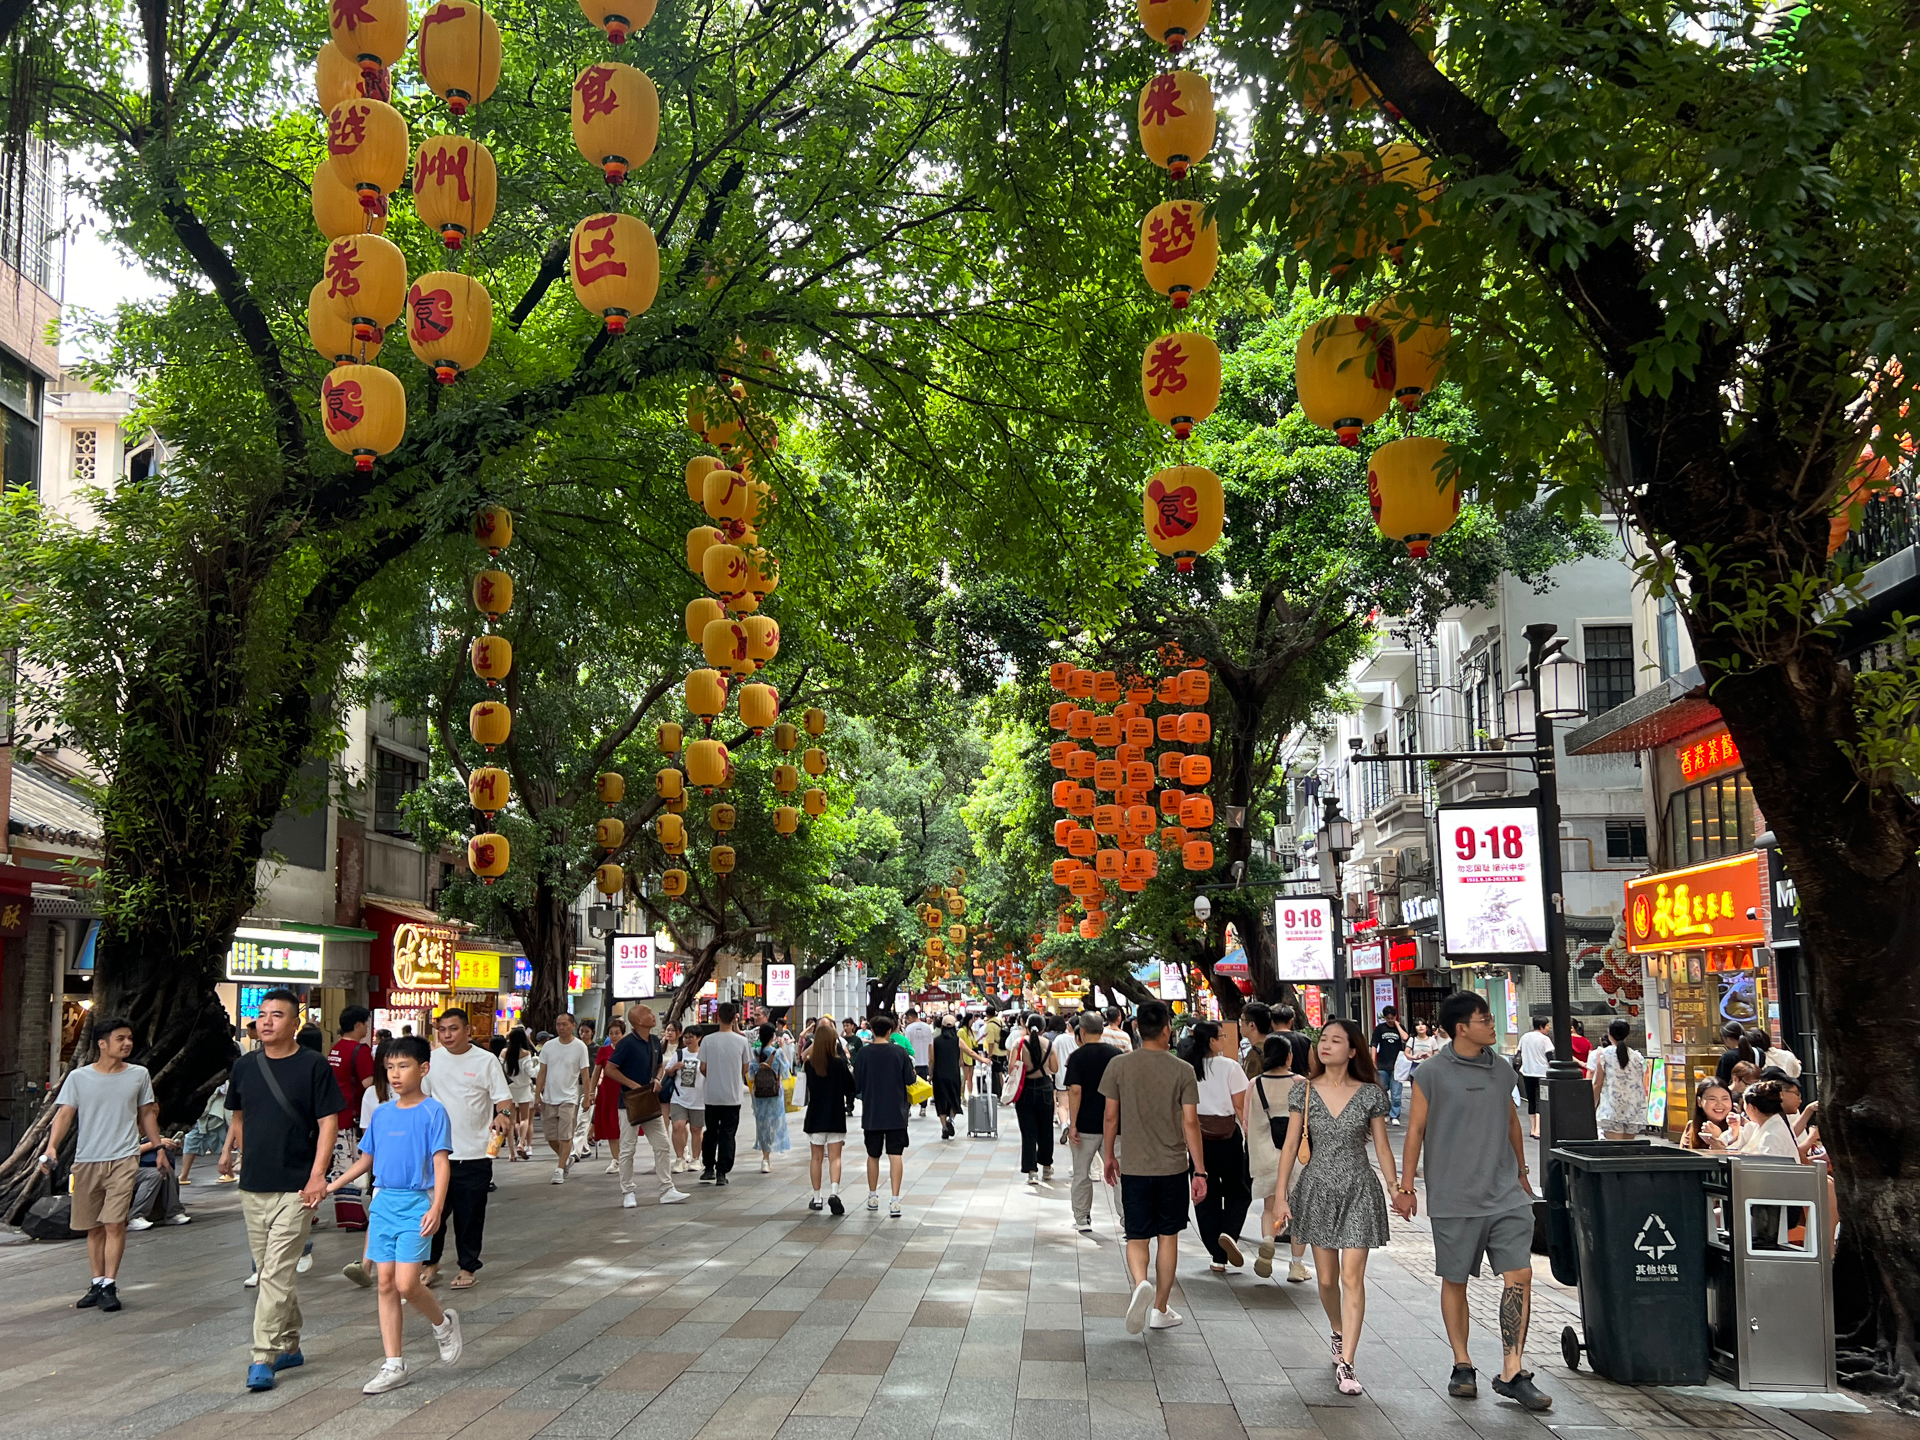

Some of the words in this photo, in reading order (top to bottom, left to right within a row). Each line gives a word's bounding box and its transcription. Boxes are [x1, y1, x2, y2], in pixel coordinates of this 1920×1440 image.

[328, 105, 371, 156] 越
[413, 145, 470, 202] 州
[1149, 204, 1196, 264] 越
[1146, 337, 1190, 397] 秀
[1776, 879, 1797, 908] M
[1635, 1264, 1679, 1275] 其他垃圾
